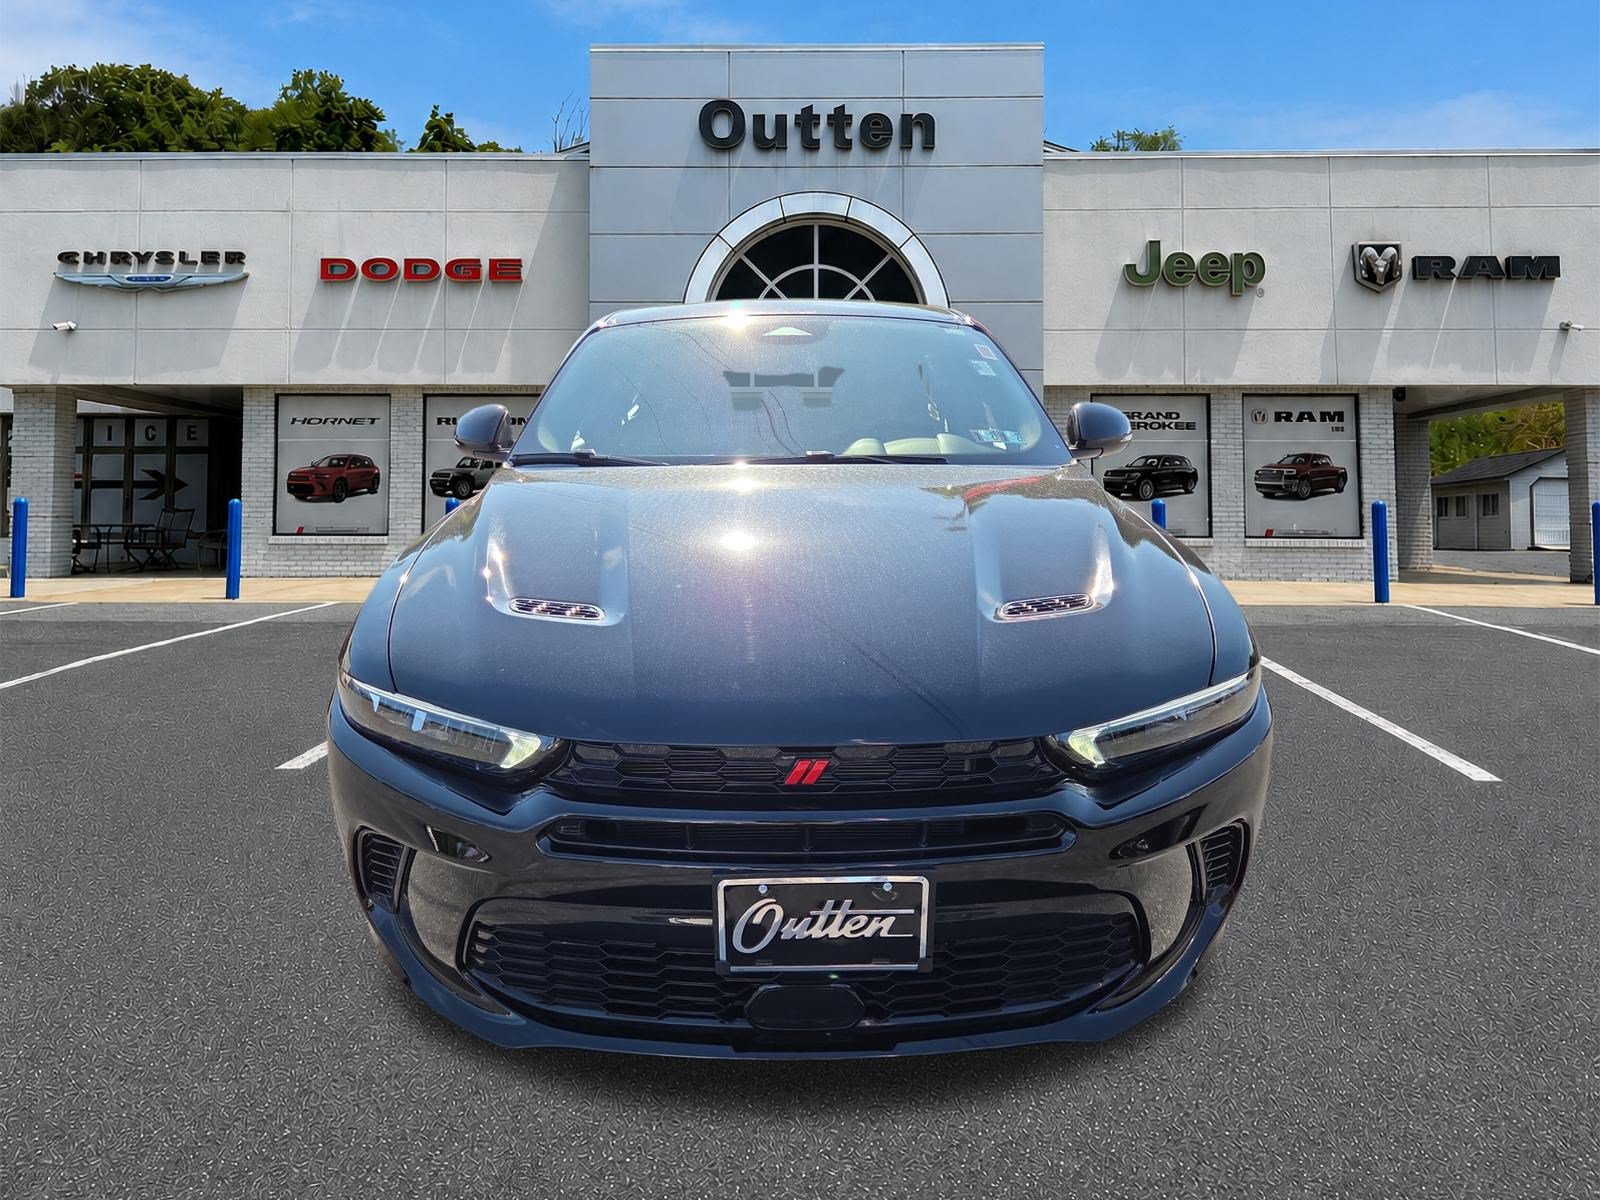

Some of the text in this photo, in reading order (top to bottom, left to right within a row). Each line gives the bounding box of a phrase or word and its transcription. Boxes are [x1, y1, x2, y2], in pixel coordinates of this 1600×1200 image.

[699, 99, 936, 150] Outten
[57, 250, 247, 266] CHRYSLER
[320, 257, 523, 282] DODGE
[1123, 240, 1266, 297] Jeep
[1411, 255, 1561, 280] RAM
[290, 417, 381, 426] HORNET
[1130, 421, 1197, 431] EROKEE
[1274, 410, 1344, 422] RAM
[732, 898, 914, 954] Outten
